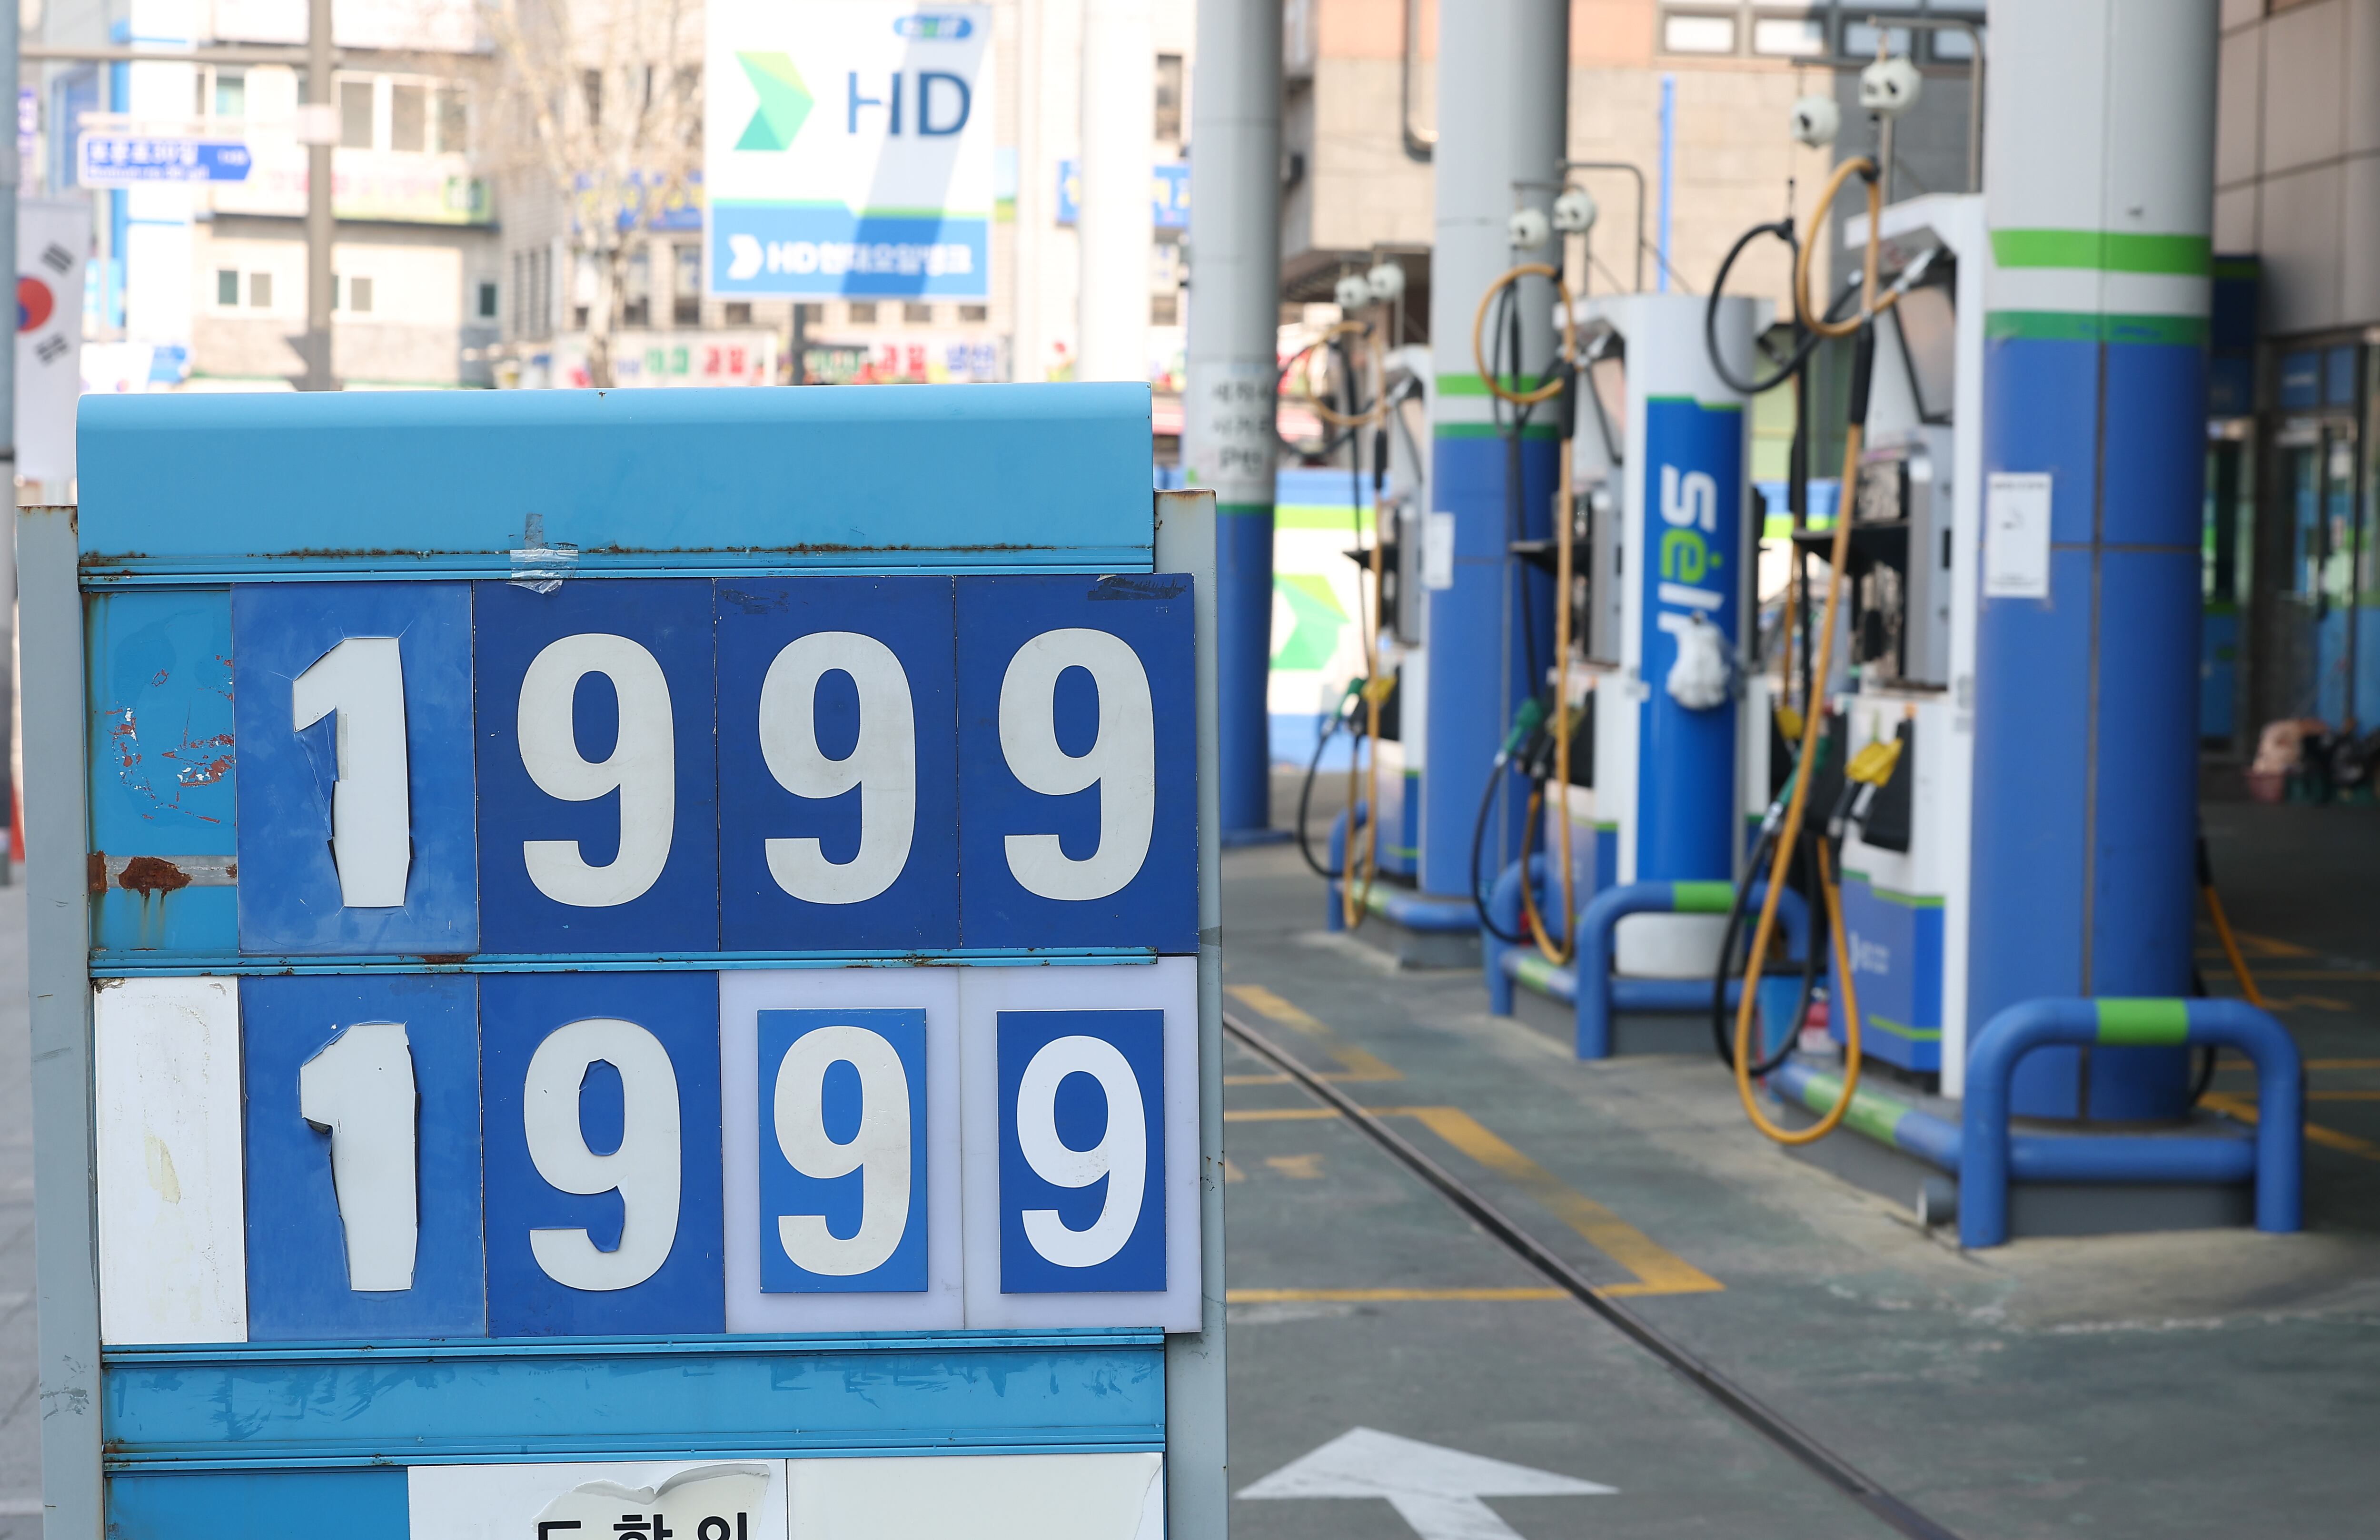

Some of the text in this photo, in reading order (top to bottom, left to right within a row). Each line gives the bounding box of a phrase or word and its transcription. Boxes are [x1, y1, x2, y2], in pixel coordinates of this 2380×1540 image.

[848, 71, 972, 137] HD
[292, 628, 1155, 908] 1999
[299, 1018, 1147, 1292] 1999
